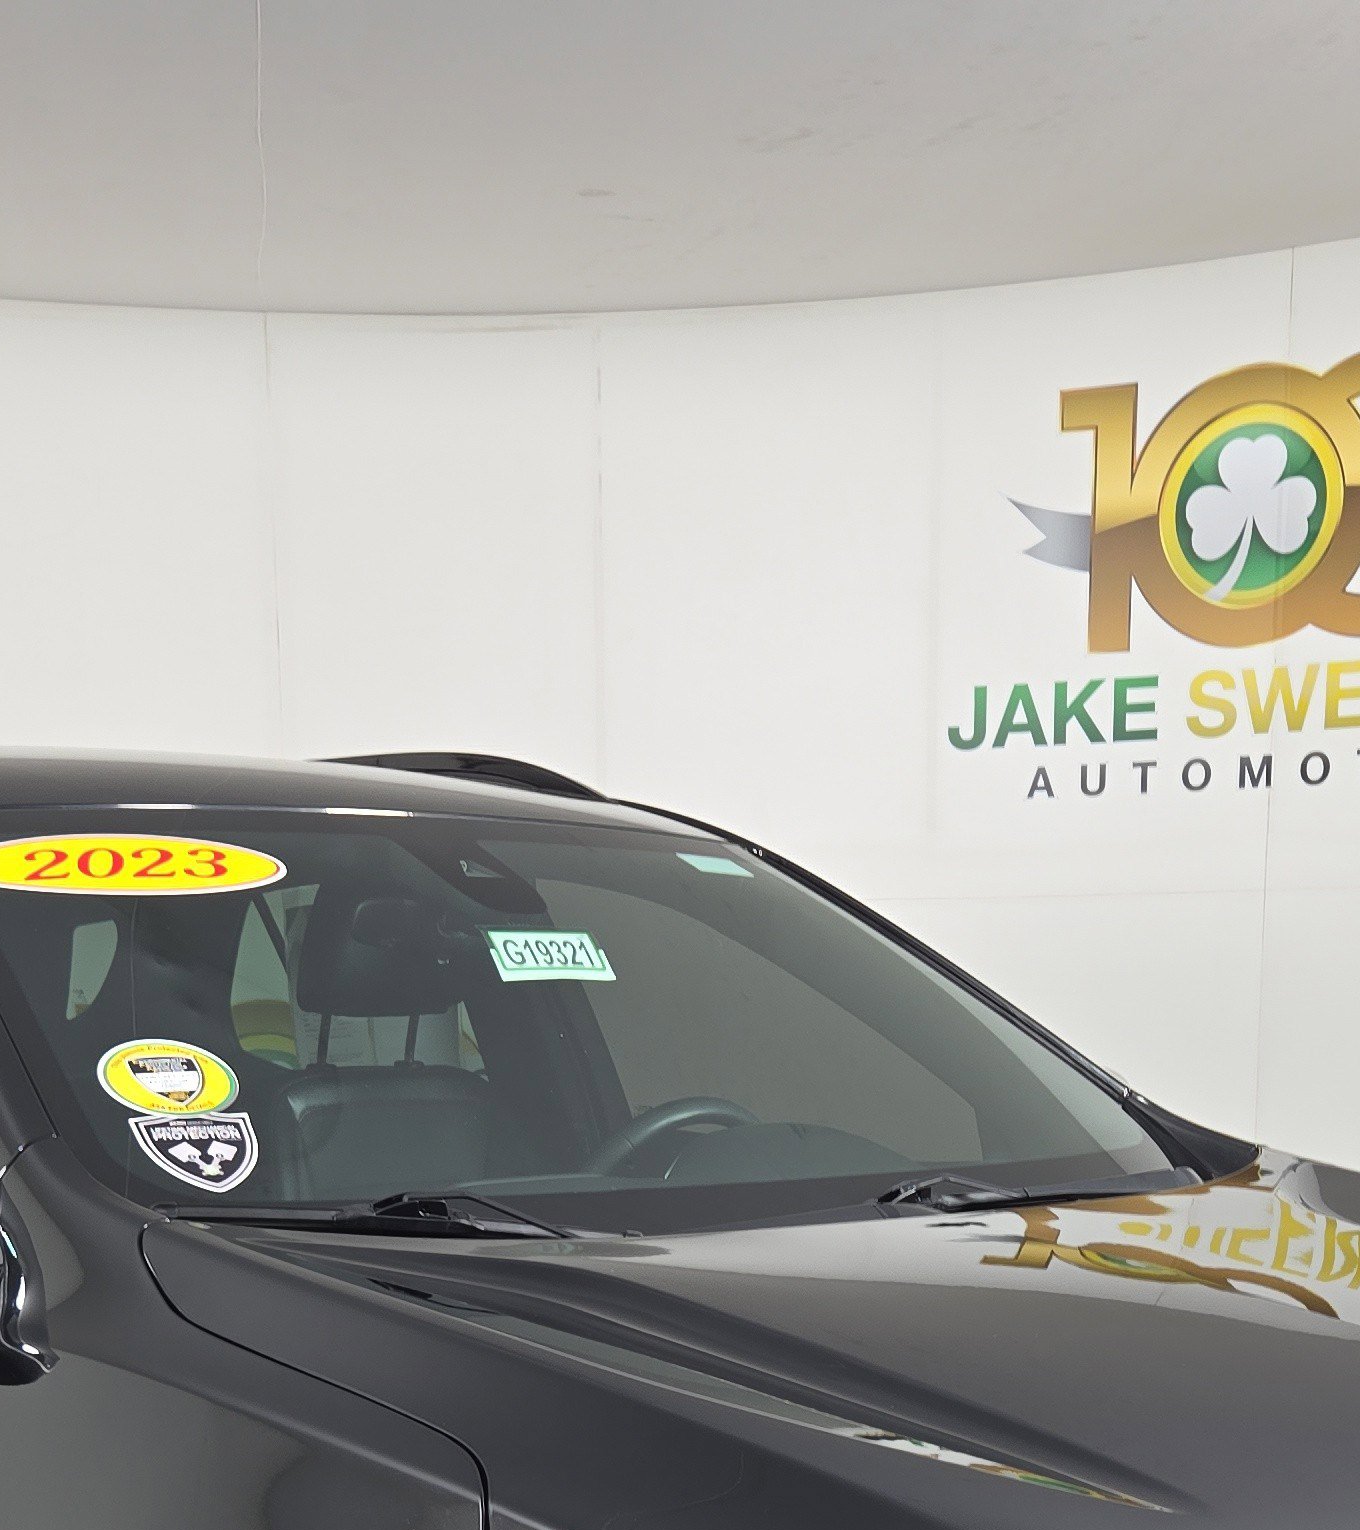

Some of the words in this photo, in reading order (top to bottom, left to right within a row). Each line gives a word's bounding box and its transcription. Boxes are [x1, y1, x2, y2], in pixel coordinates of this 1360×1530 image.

[948, 675, 1159, 750] JAKE
[24, 848, 228, 880] 2023
[502, 939, 596, 967] G19321
